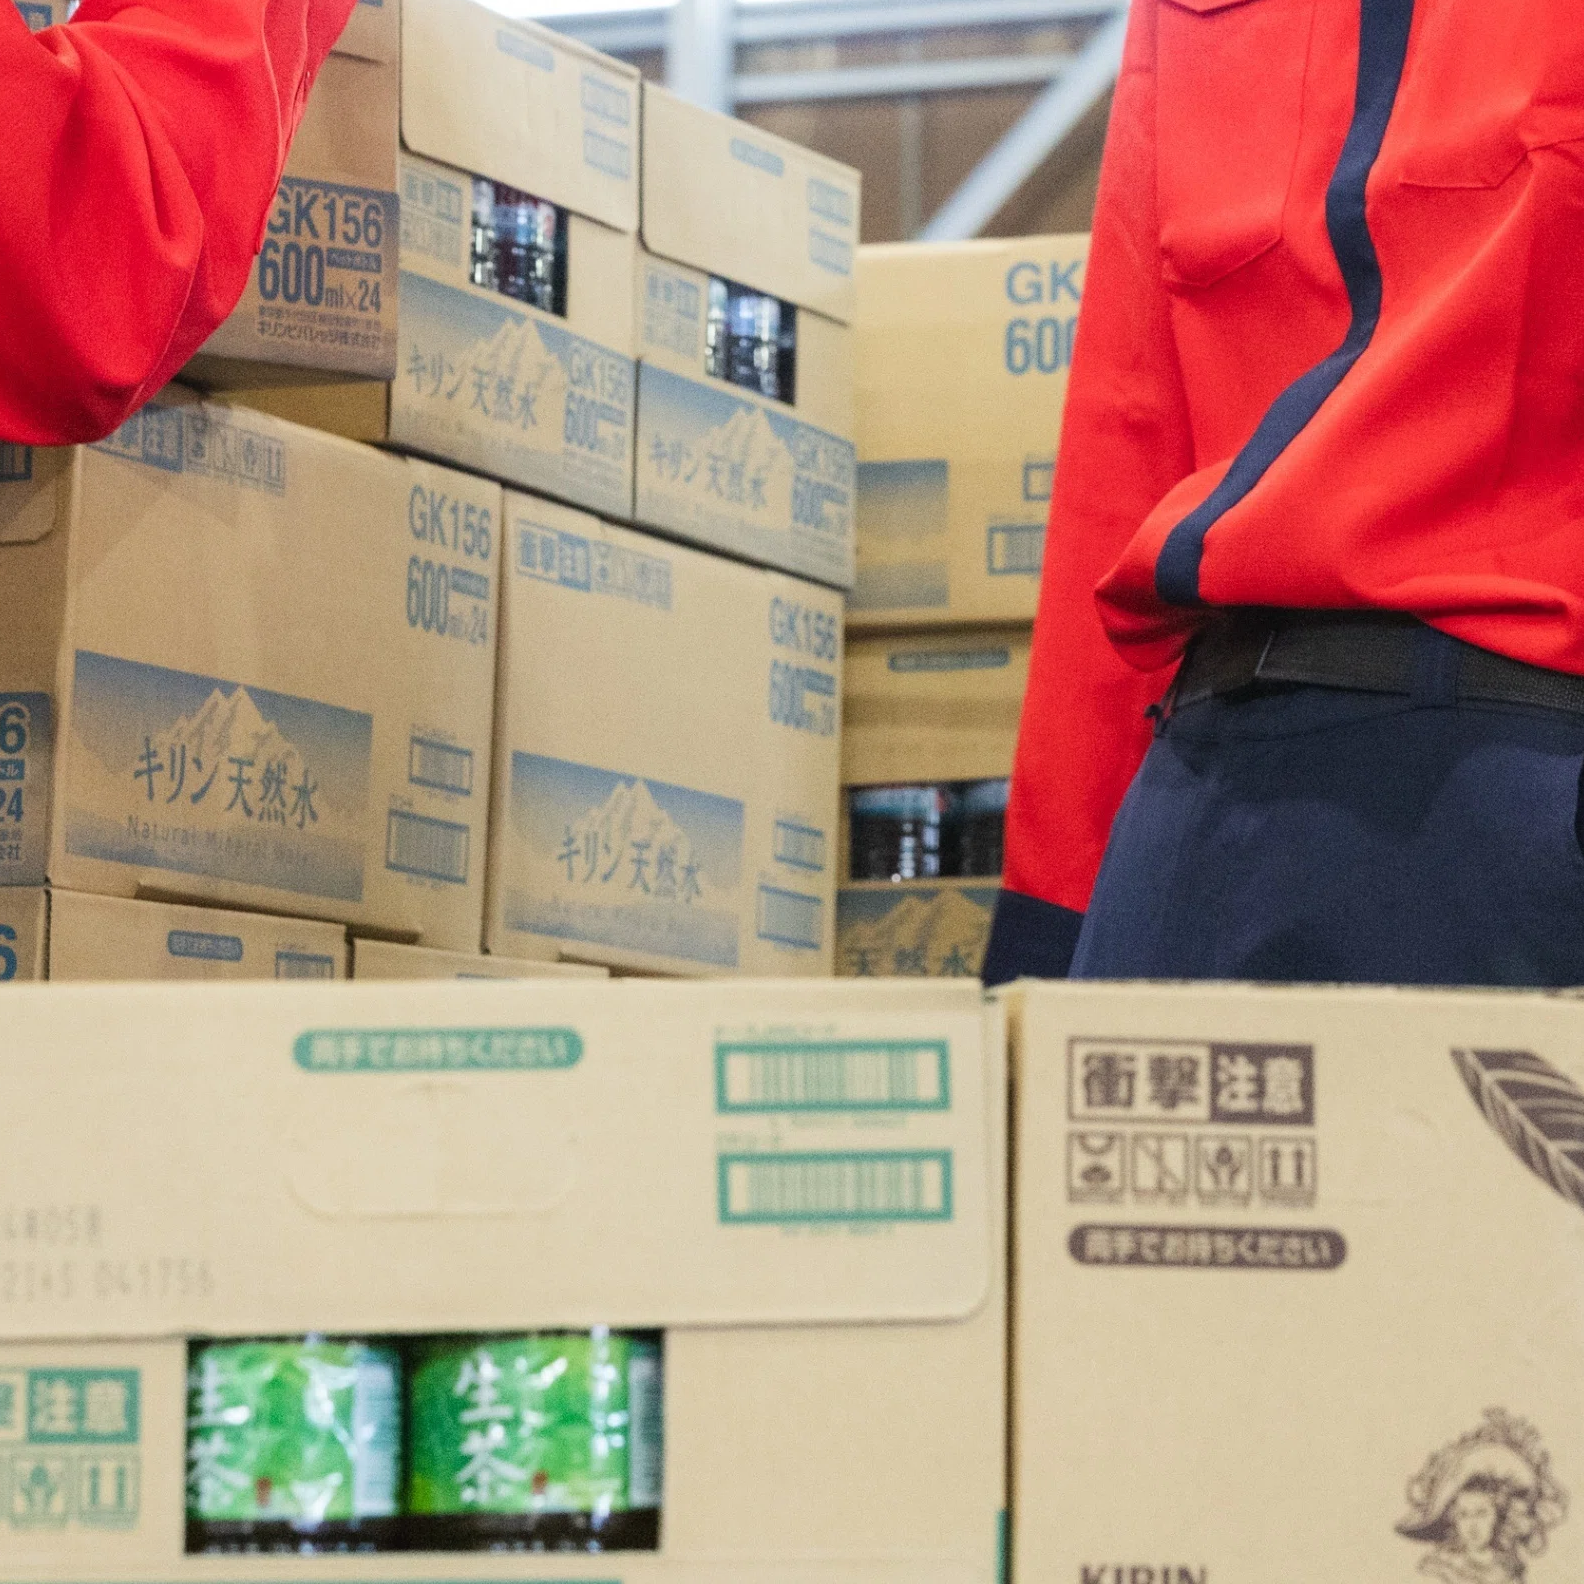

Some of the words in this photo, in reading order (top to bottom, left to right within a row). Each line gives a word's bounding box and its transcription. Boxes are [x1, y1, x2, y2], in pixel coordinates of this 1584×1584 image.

[267, 188, 383, 248] GK156
[408, 484, 491, 561] GK156
[133, 736, 318, 830] キリン天然水
[1082, 1052, 1303, 1115] 衝撃注意
[454, 1350, 527, 1507] 生茶
